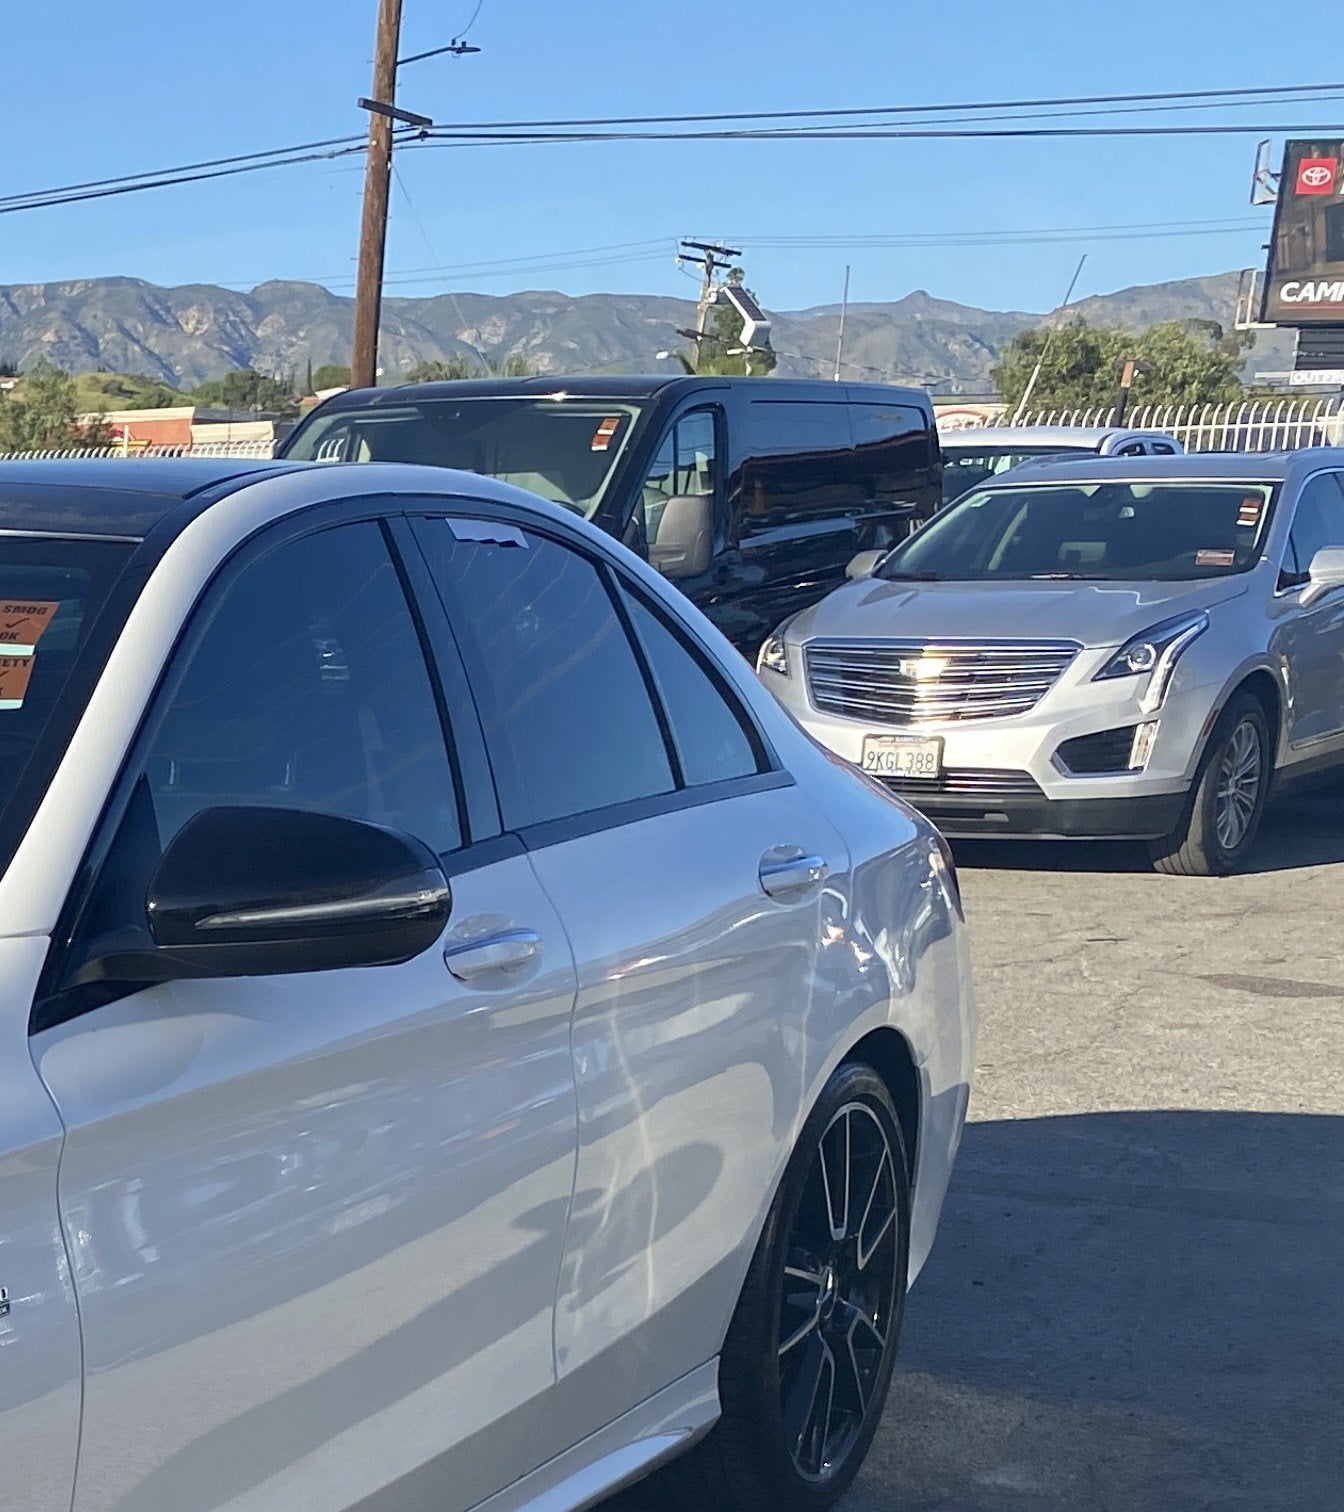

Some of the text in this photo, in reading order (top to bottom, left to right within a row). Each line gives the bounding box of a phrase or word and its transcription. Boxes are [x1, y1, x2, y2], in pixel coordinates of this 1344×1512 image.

[1280, 281, 1344, 303] CAM
[2, 604, 48, 616] SMOG
[866, 750, 935, 771] 9KGL388
